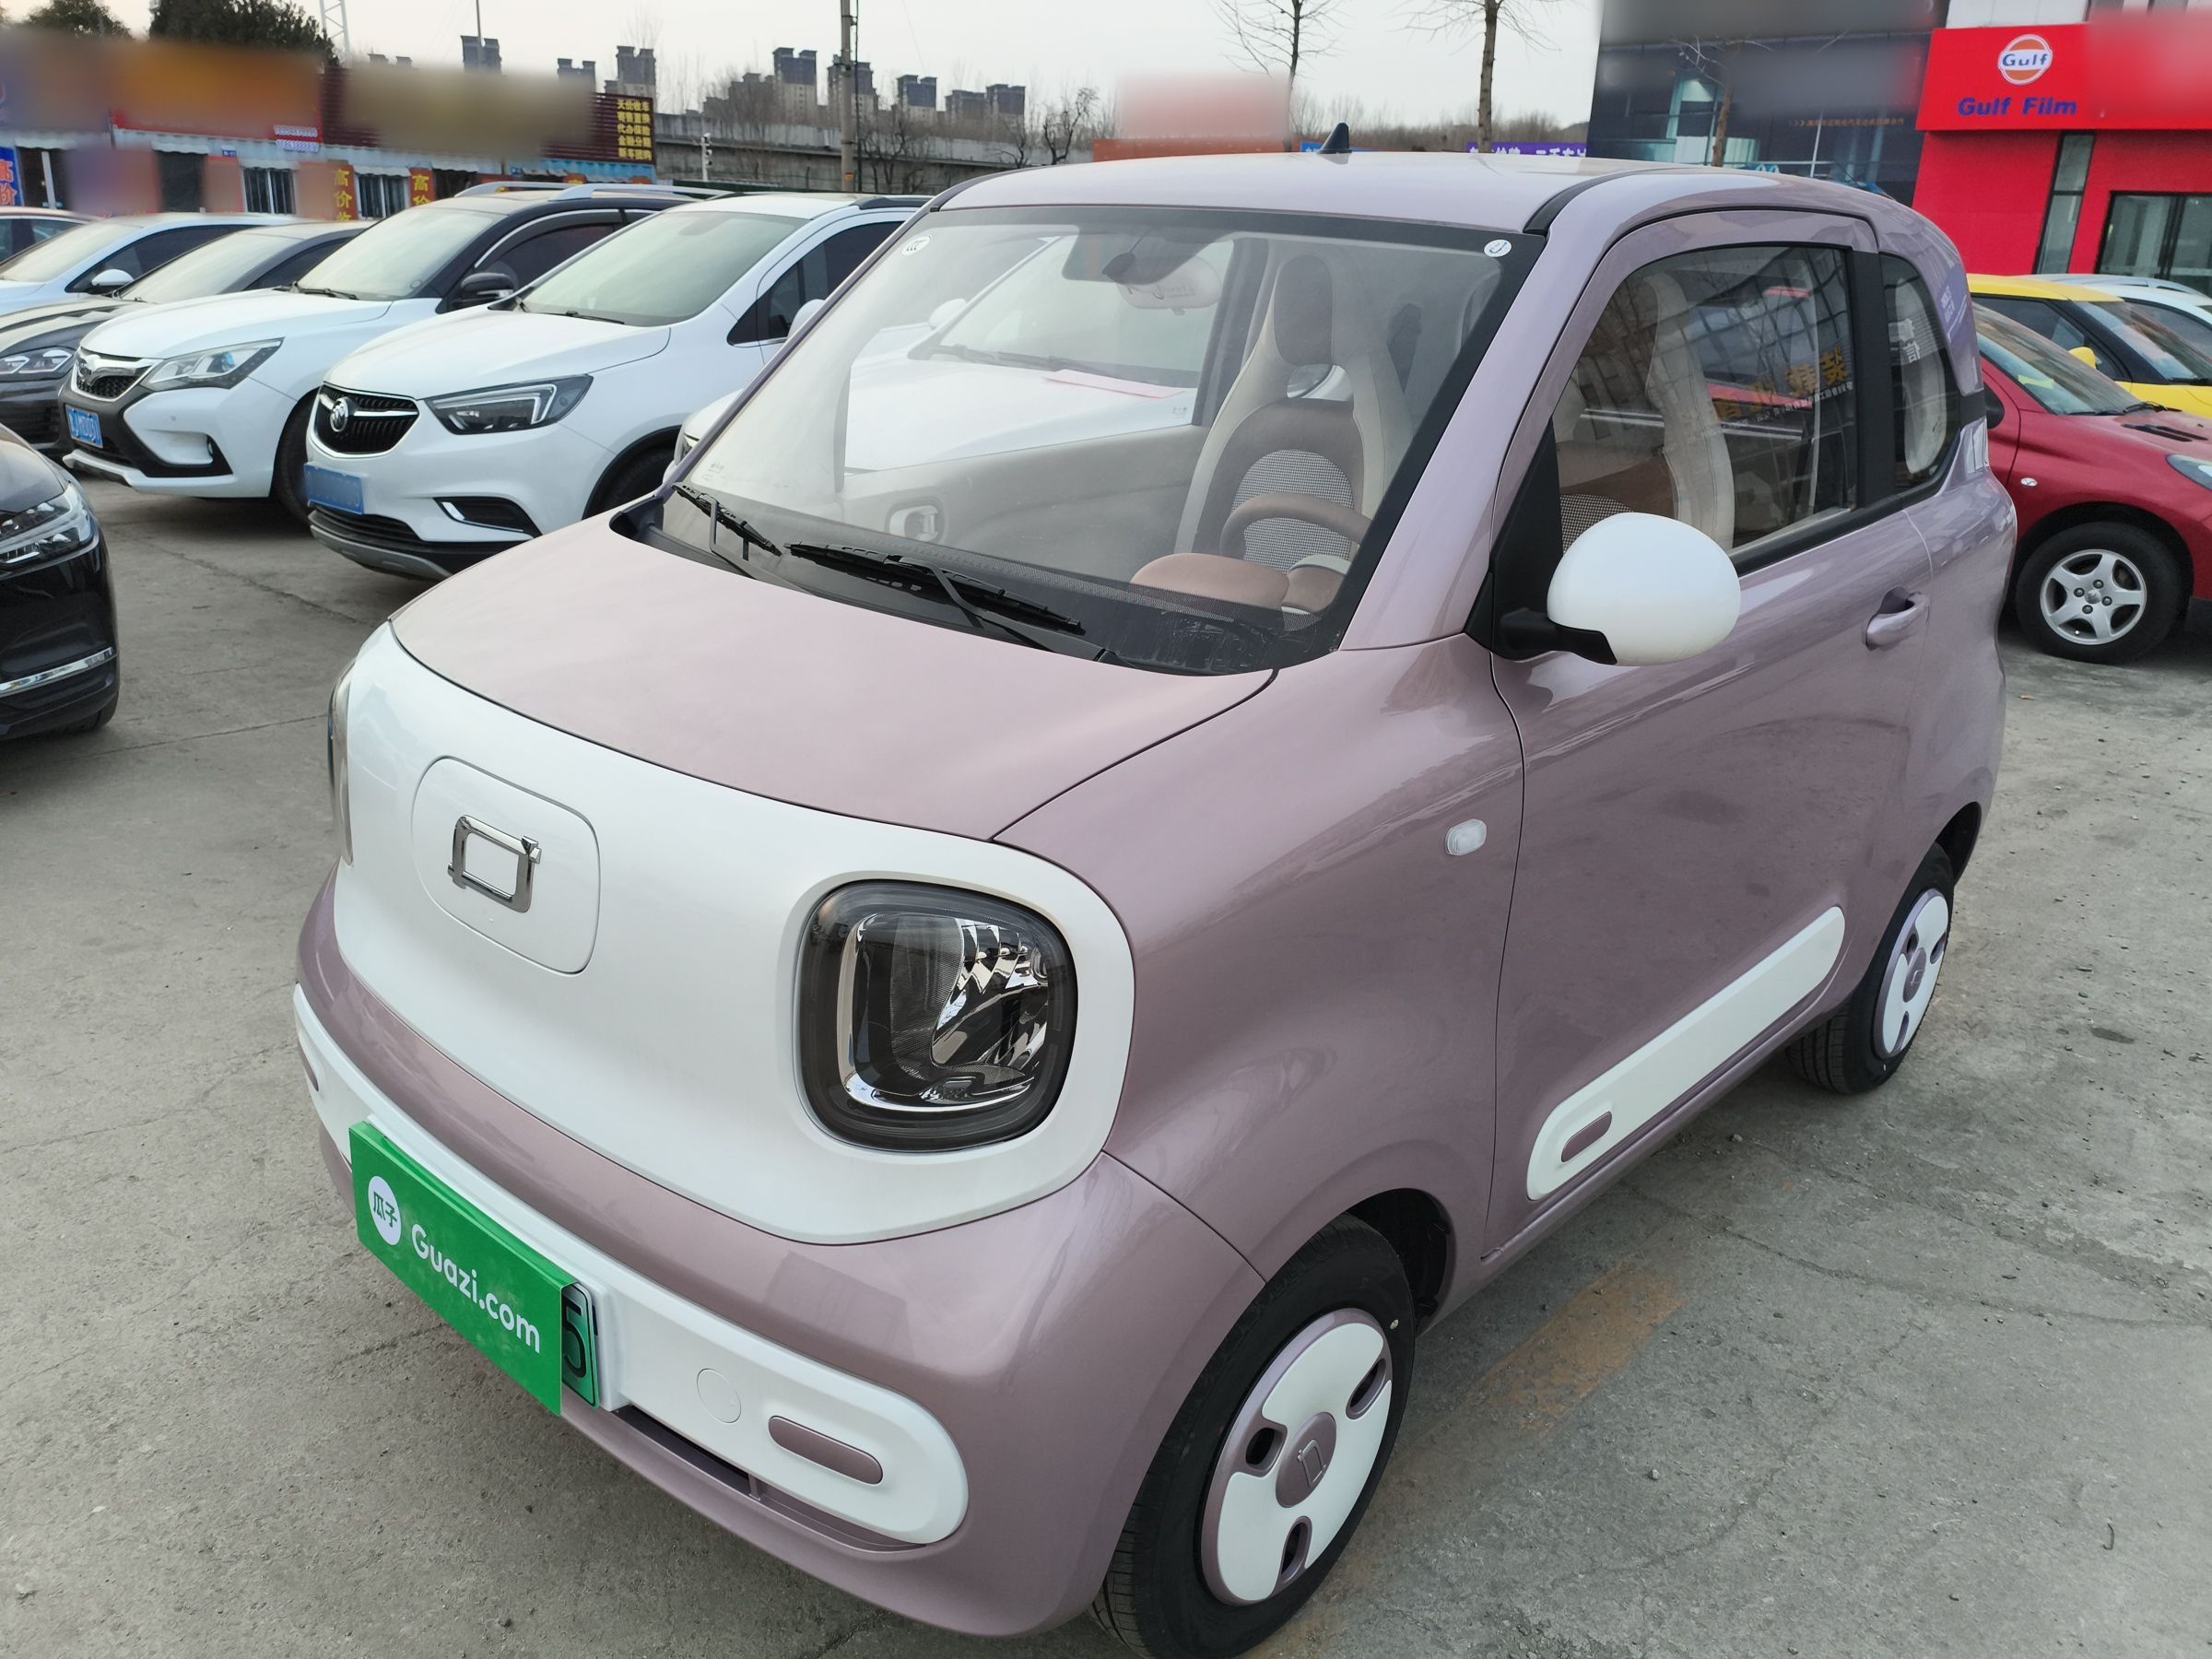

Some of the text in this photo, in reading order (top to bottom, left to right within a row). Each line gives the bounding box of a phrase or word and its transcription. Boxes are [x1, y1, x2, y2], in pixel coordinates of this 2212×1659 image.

[2002, 53, 2048, 67] Gulf
[1958, 97, 2077, 116] Gulf Film
[372, 1191, 398, 1229] 瓜子
[411, 1223, 540, 1355] Guazi.com
